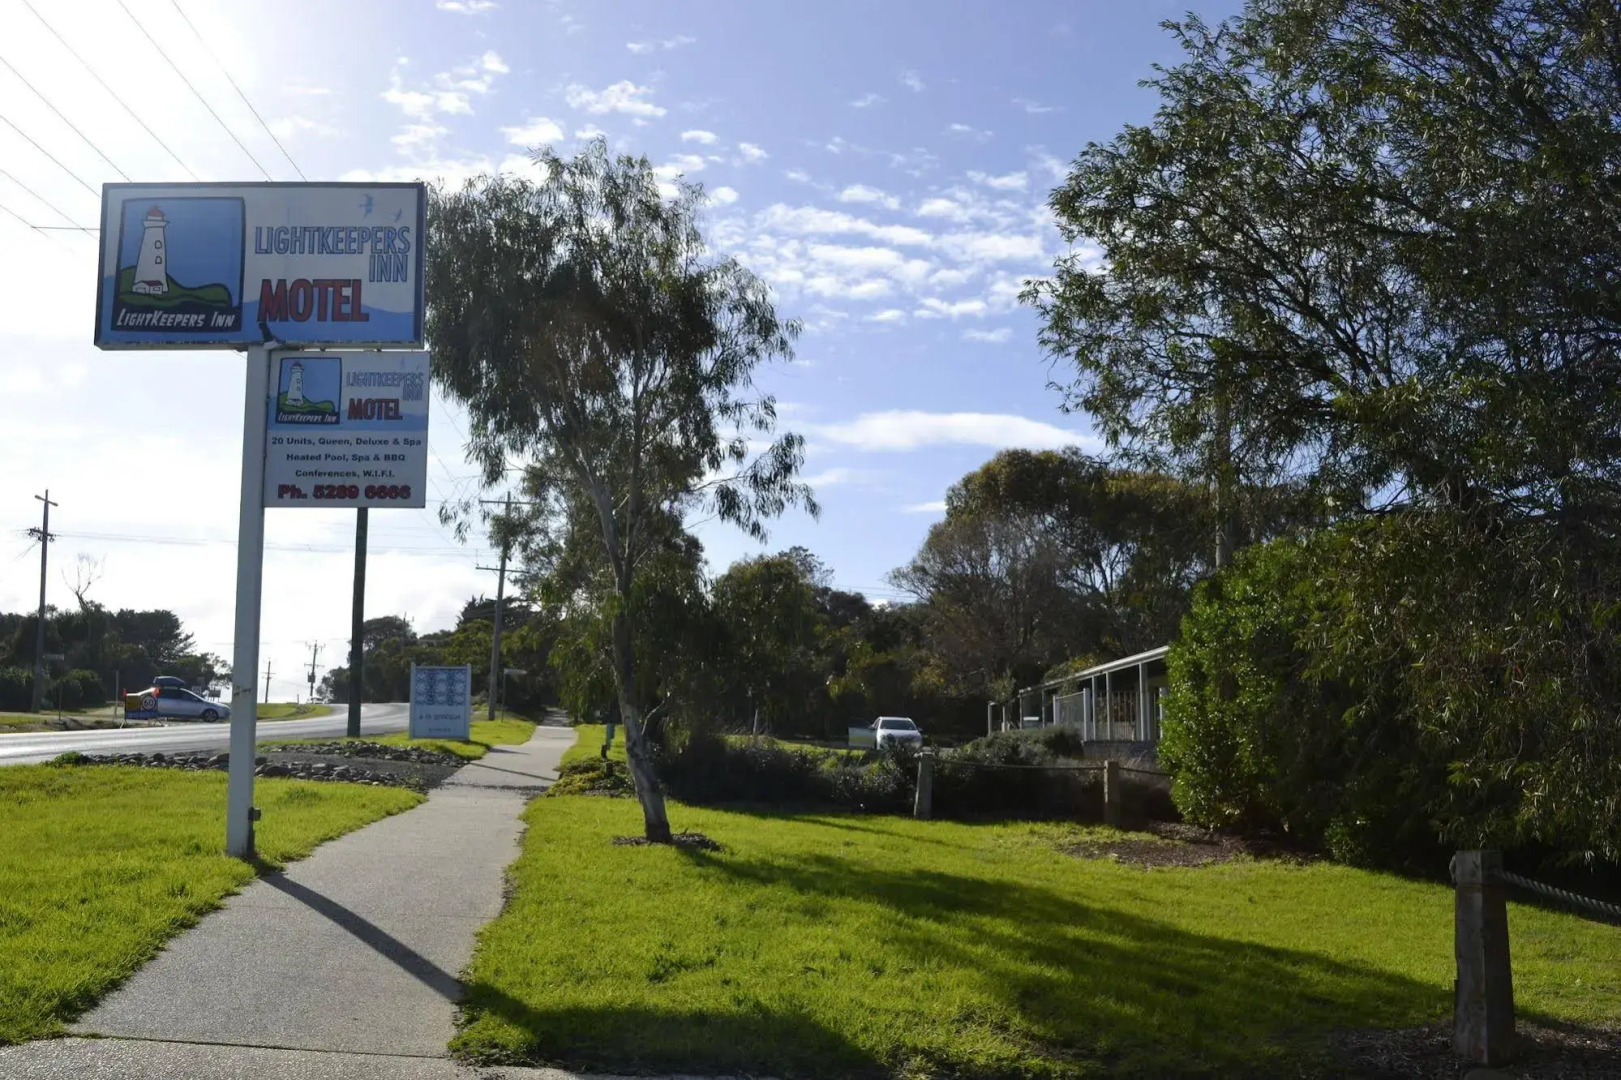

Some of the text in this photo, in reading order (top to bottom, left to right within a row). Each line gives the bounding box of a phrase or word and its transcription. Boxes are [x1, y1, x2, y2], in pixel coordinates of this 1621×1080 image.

[254, 226, 411, 255] LIGHTKEEPERS
[368, 254, 408, 283] INN
[257, 278, 370, 323] MOTEL
[116, 308, 235, 328] LIGHTKEEPERS INN
[346, 372, 424, 387] LIGHTKEEPERS
[403, 385, 423, 401] INN
[348, 398, 402, 420] MOTEL
[323, 414, 338, 423] INN
[271, 437, 422, 448] 20 Units, Queen, Deluxe & Spa
[286, 453, 406, 463] Heated Pool, Spa & BBQ
[295, 469, 360, 479] Conferences,
[277, 484, 308, 499] Ph.
